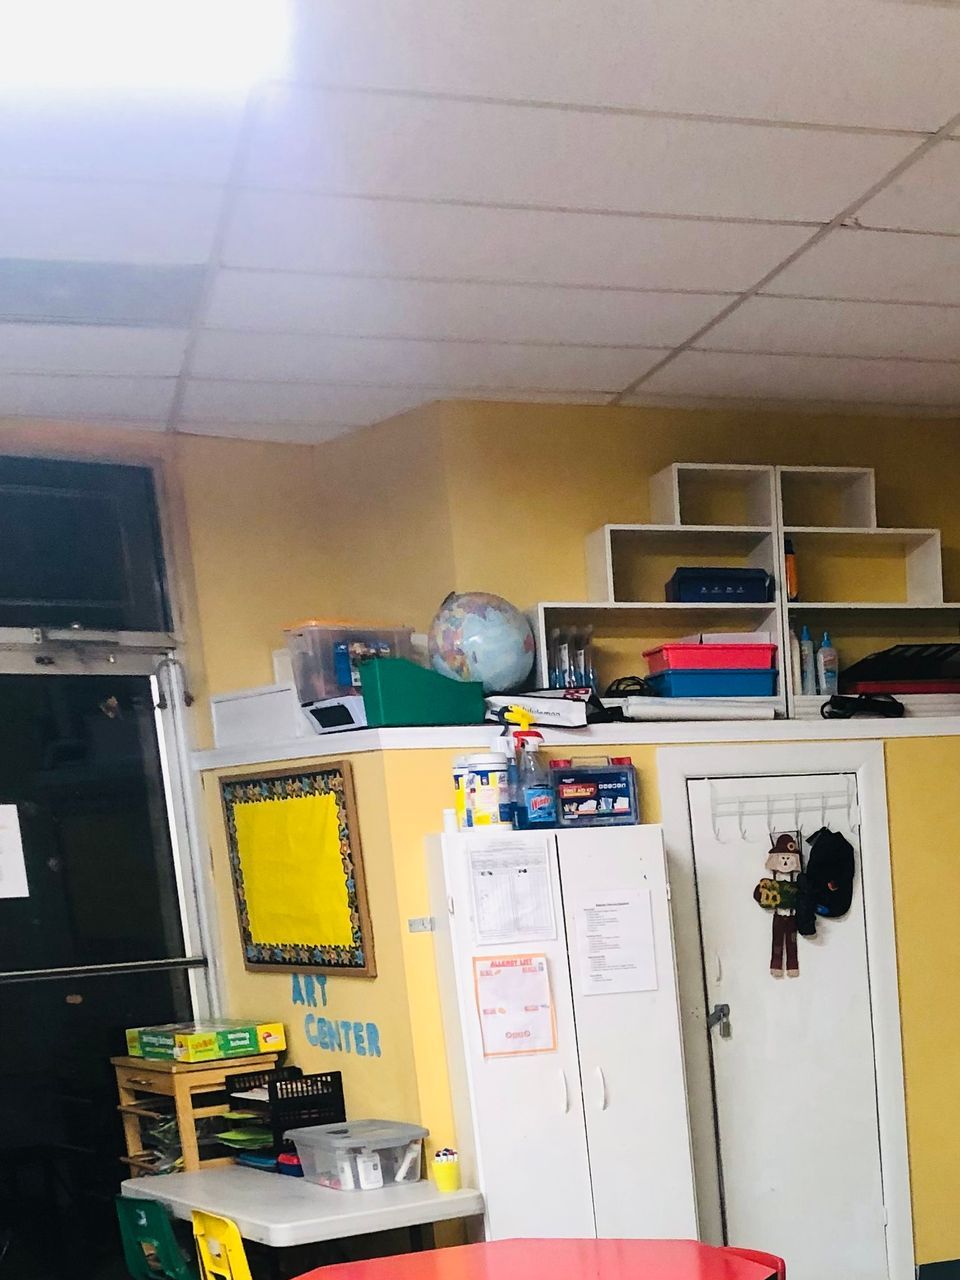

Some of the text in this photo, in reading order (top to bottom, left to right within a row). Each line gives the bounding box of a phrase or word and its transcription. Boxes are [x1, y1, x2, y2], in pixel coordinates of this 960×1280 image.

[531, 796, 552, 810] Wind
[292, 973, 327, 1008] ART
[304, 1013, 381, 1058] CENTER
